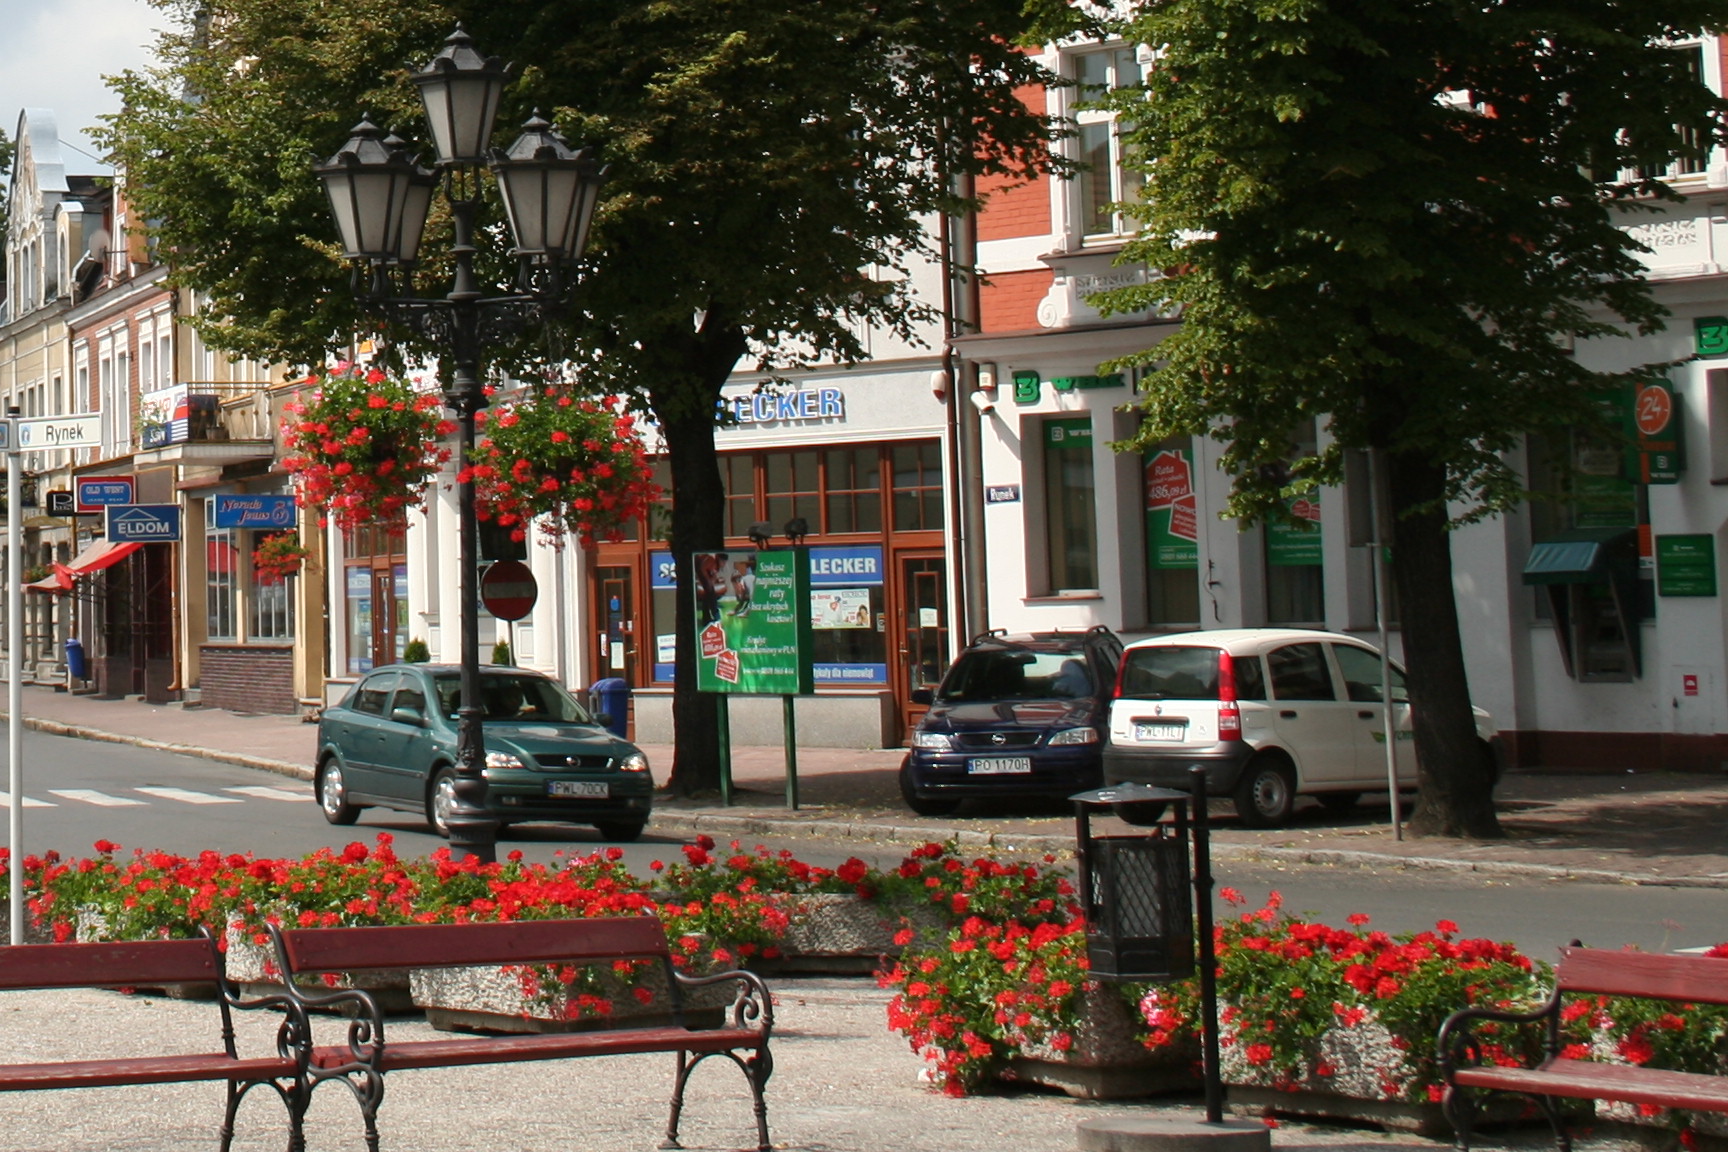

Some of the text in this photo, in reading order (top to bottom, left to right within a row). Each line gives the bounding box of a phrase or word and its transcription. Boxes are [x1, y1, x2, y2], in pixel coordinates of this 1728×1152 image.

[715, 388, 846, 424] ECKER
[1641, 396, 1661, 421] 24
[45, 422, 84, 446] Rynek
[85, 486, 101, 495] OLD
[117, 522, 170, 535] ELDOM
[759, 562, 785, 572] Szukasz
[811, 557, 876, 574] LECKER
[974, 759, 991, 771] PO
[555, 782, 577, 795] PWL
